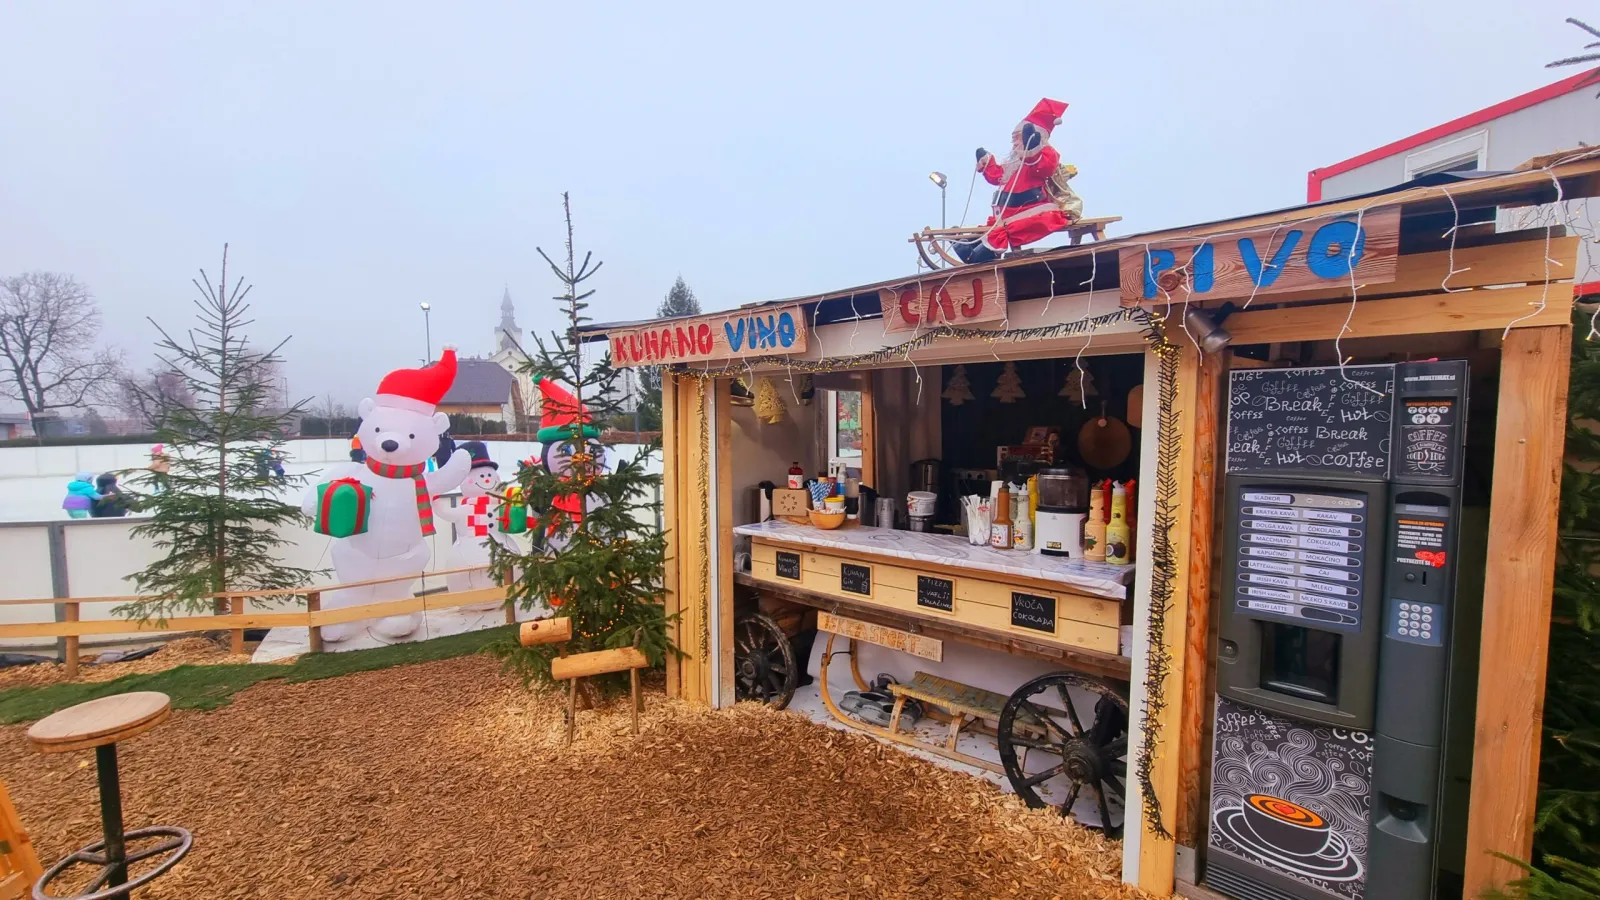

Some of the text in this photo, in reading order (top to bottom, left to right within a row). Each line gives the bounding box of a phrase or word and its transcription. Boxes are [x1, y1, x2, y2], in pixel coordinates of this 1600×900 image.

[1143, 221, 1366, 299] PIVO
[900, 278, 984, 324] CAJ
[614, 312, 795, 362] KUHANO VINO
[1316, 426, 1368, 440] Break
[1408, 429, 1448, 442] COFFEE
[1308, 525, 1342, 535] ČOKOLADA
[1306, 538, 1341, 547] ČOKOLADA
[1257, 549, 1288, 557] KAPUČINO
[1306, 554, 1341, 563] MOKAČINO
[1318, 568, 1330, 576] ČAJ
[1311, 583, 1333, 592] MLEKO
[1013, 594, 1045, 612] VROČA
[1270, 604, 1287, 612] LATTE
[1301, 595, 1323, 604] MLEKO
[1329, 600, 1347, 608] KAVO
[1013, 608, 1054, 628] ČOKOLADA
